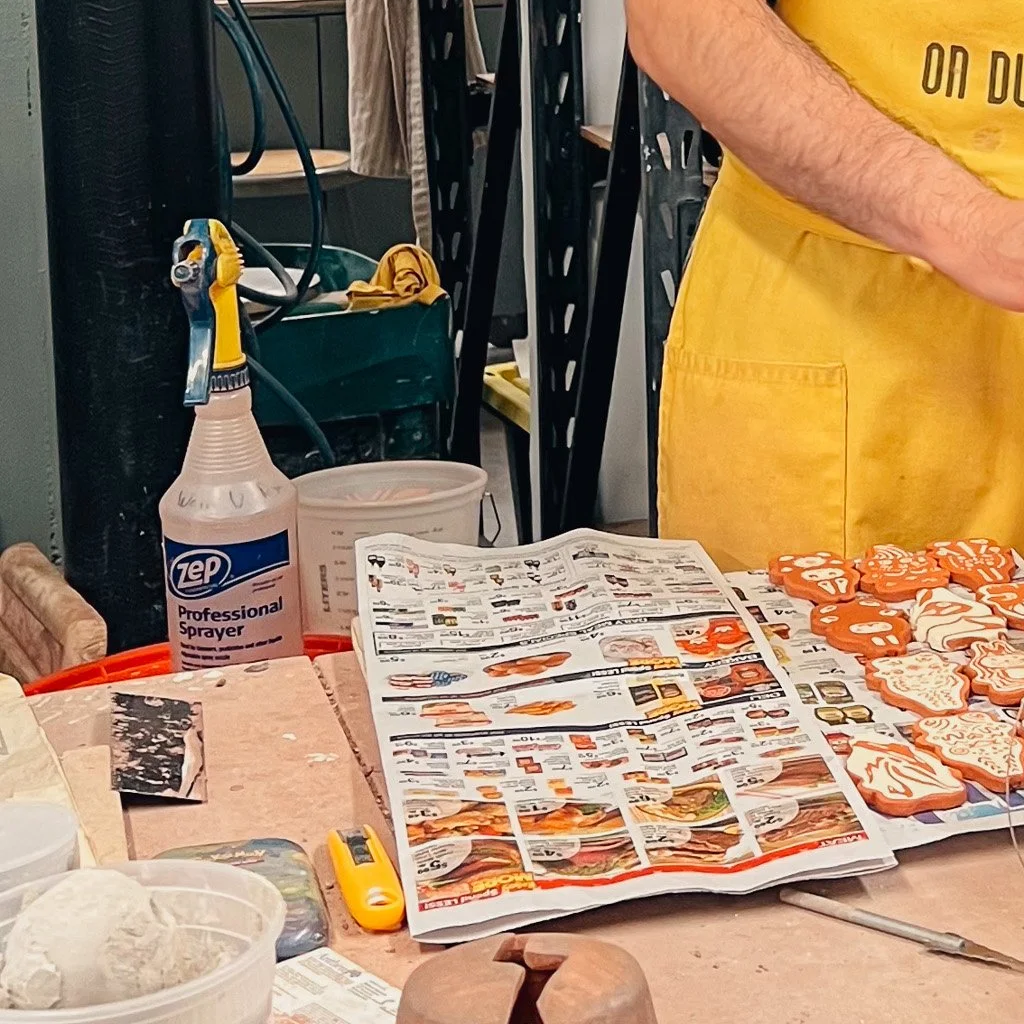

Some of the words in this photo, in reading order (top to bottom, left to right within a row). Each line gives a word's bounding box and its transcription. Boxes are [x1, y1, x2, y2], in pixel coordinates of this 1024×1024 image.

[921, 42, 969, 99] ON
[178, 596, 283, 622] Professional
[179, 621, 245, 642] Sprayer
[704, 654, 758, 668] BAKERY
[818, 833, 862, 847] MEAT
